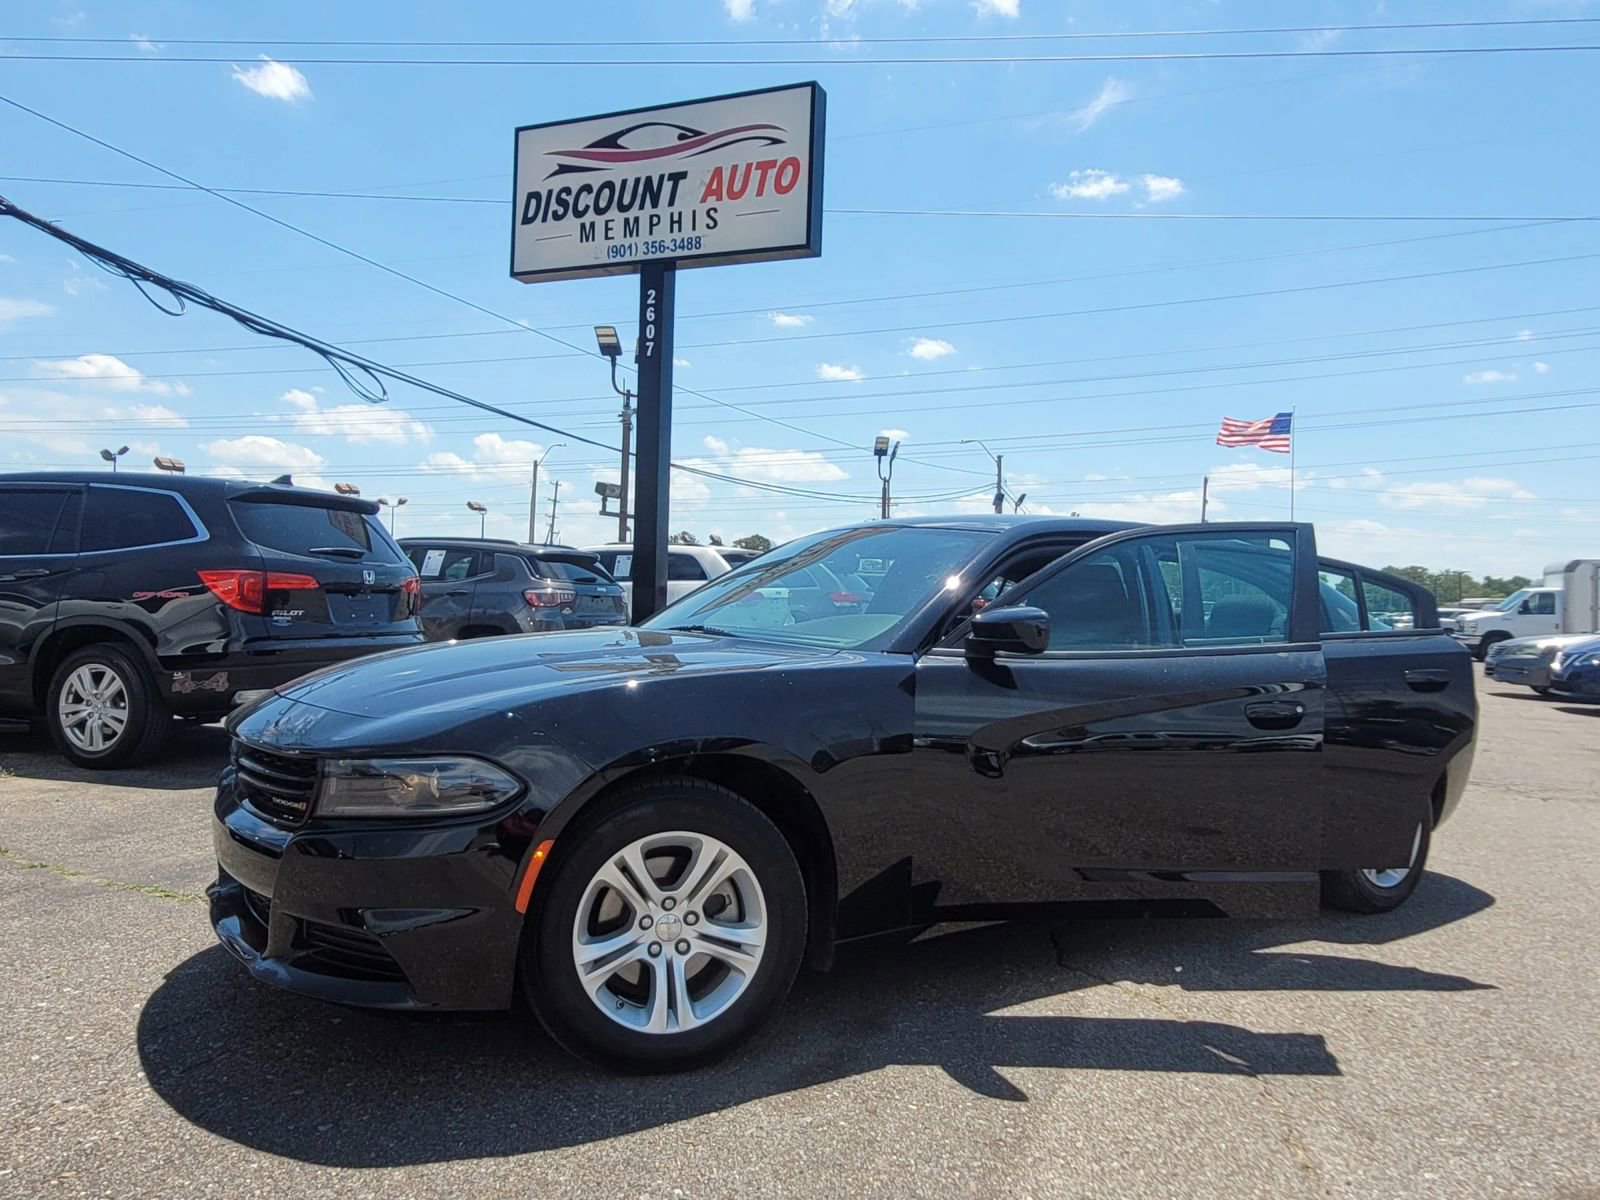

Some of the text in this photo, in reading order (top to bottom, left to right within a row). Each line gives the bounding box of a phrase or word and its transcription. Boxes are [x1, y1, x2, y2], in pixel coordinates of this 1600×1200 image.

[520, 156, 801, 226] DISCOUNT AUTO
[579, 207, 719, 243] MEMPHIS
[607, 235, 702, 259] (901) 356-3488
[645, 289, 656, 357] 2607
